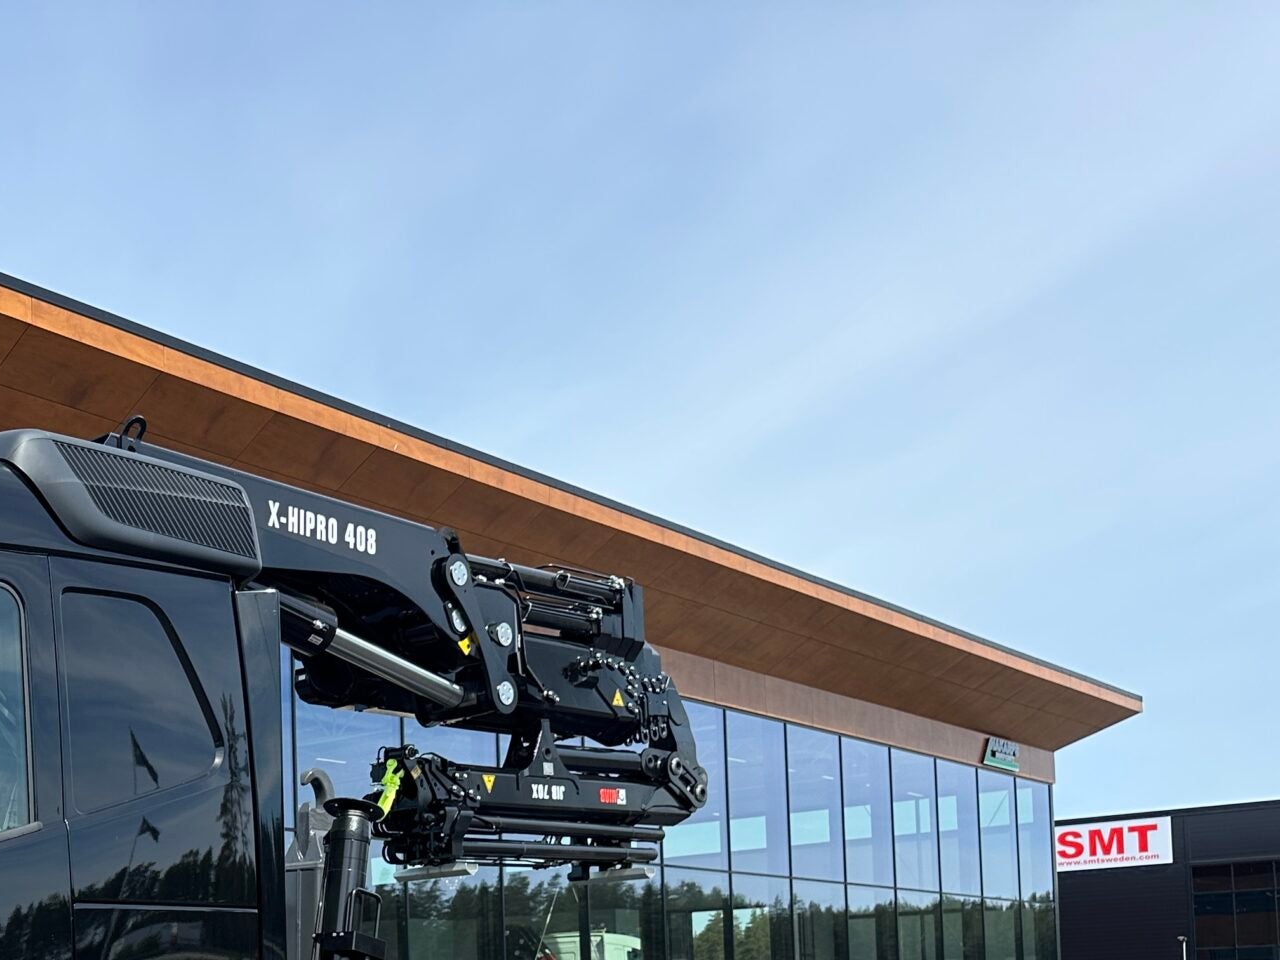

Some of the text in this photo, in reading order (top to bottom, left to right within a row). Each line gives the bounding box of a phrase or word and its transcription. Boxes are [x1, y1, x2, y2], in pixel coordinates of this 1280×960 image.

[267, 499, 377, 555] X-HIPRO 408
[1057, 824, 1158, 859] SMT
[1058, 853, 1160, 867] www.smtsweden.com
